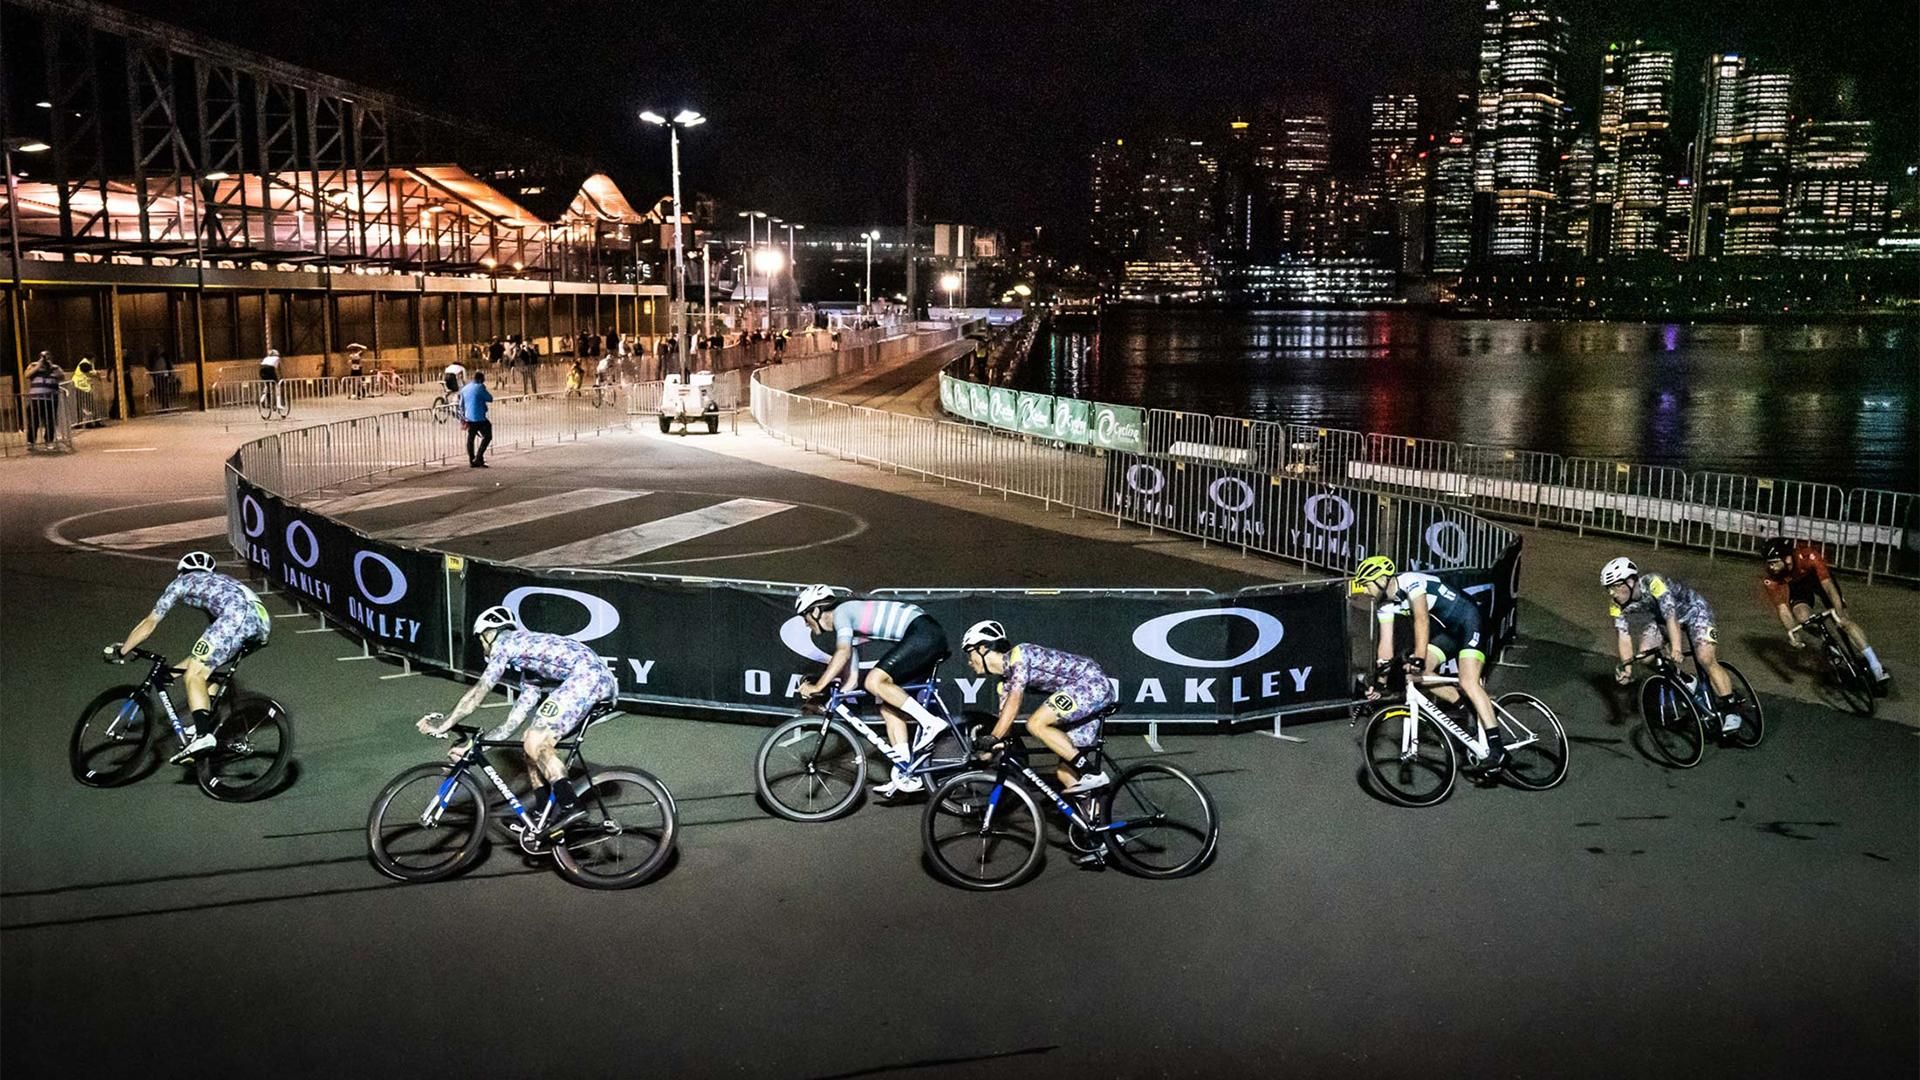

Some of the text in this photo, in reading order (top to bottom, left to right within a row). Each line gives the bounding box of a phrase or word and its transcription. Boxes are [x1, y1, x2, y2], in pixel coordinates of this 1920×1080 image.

[1113, 421, 1140, 443] Cycling
[348, 596, 422, 644] OAKLEY
[1109, 665, 1313, 704] AKLEY
